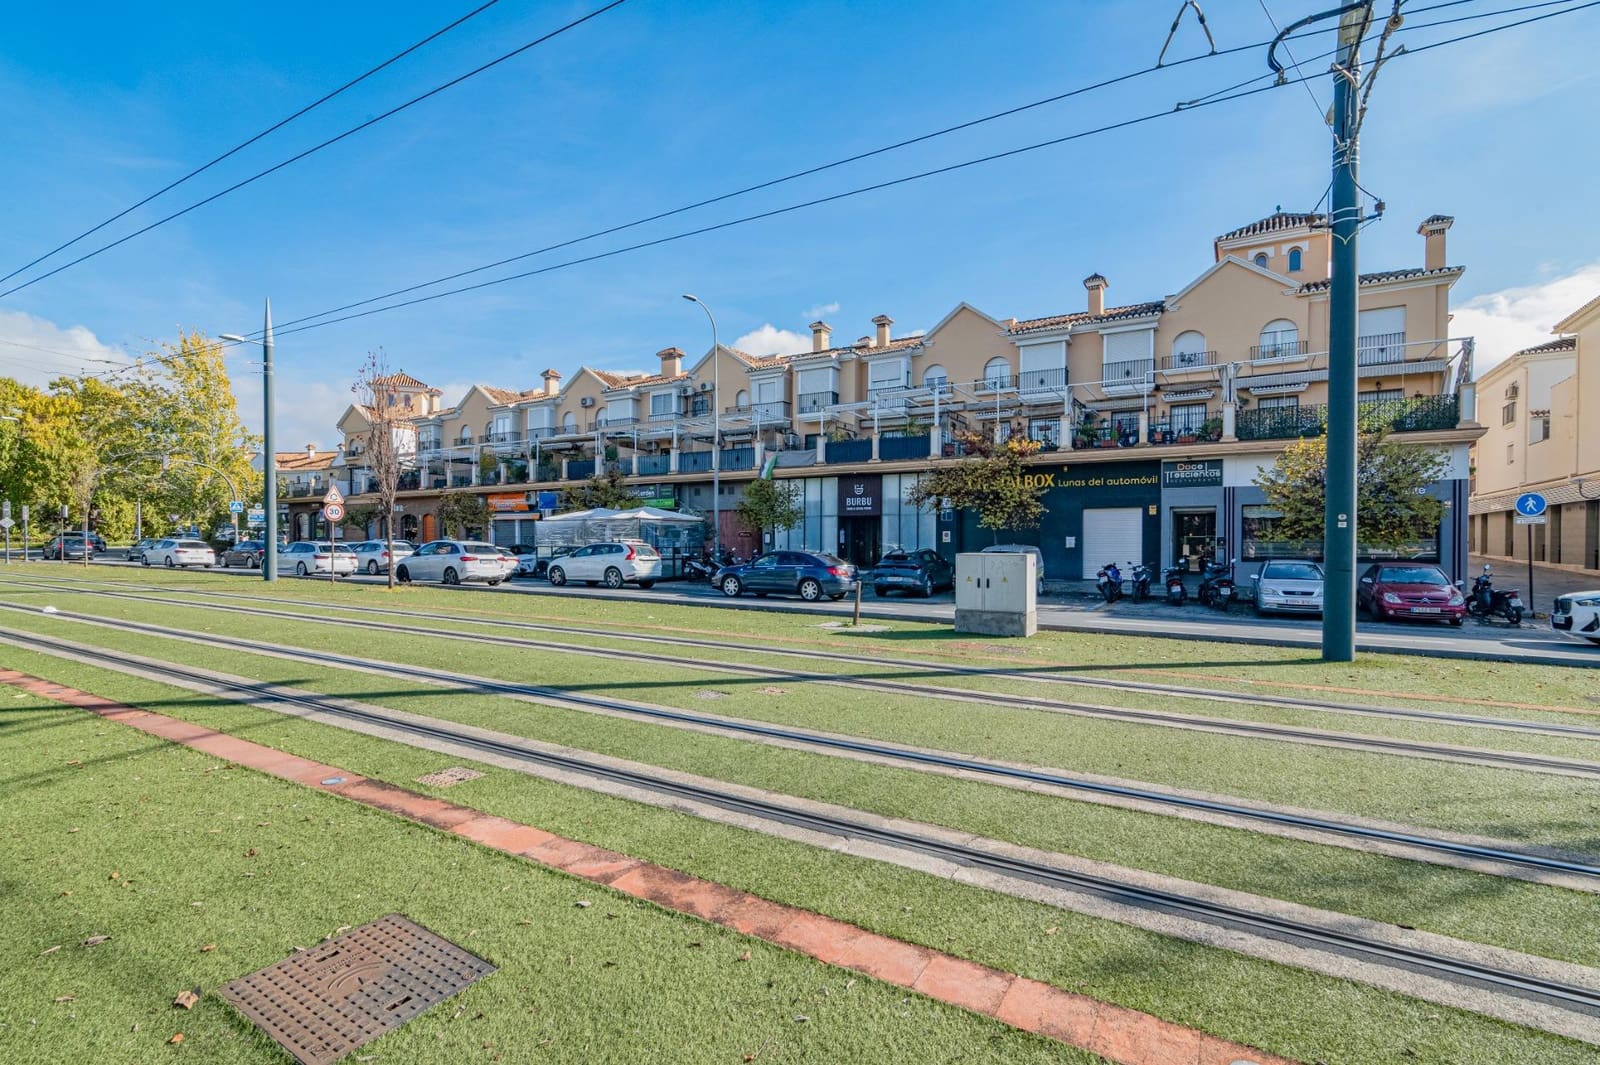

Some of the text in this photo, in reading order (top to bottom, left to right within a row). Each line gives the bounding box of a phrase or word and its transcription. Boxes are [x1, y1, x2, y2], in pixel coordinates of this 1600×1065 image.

[1177, 463, 1204, 471] Doce
[1164, 462, 1221, 484] Trescientos
[1058, 479, 1086, 487] Lunas
[1088, 477, 1104, 486] del
[1106, 475, 1158, 486] automóvil
[846, 497, 872, 506] BURBU
[329, 508, 340, 516] 30
